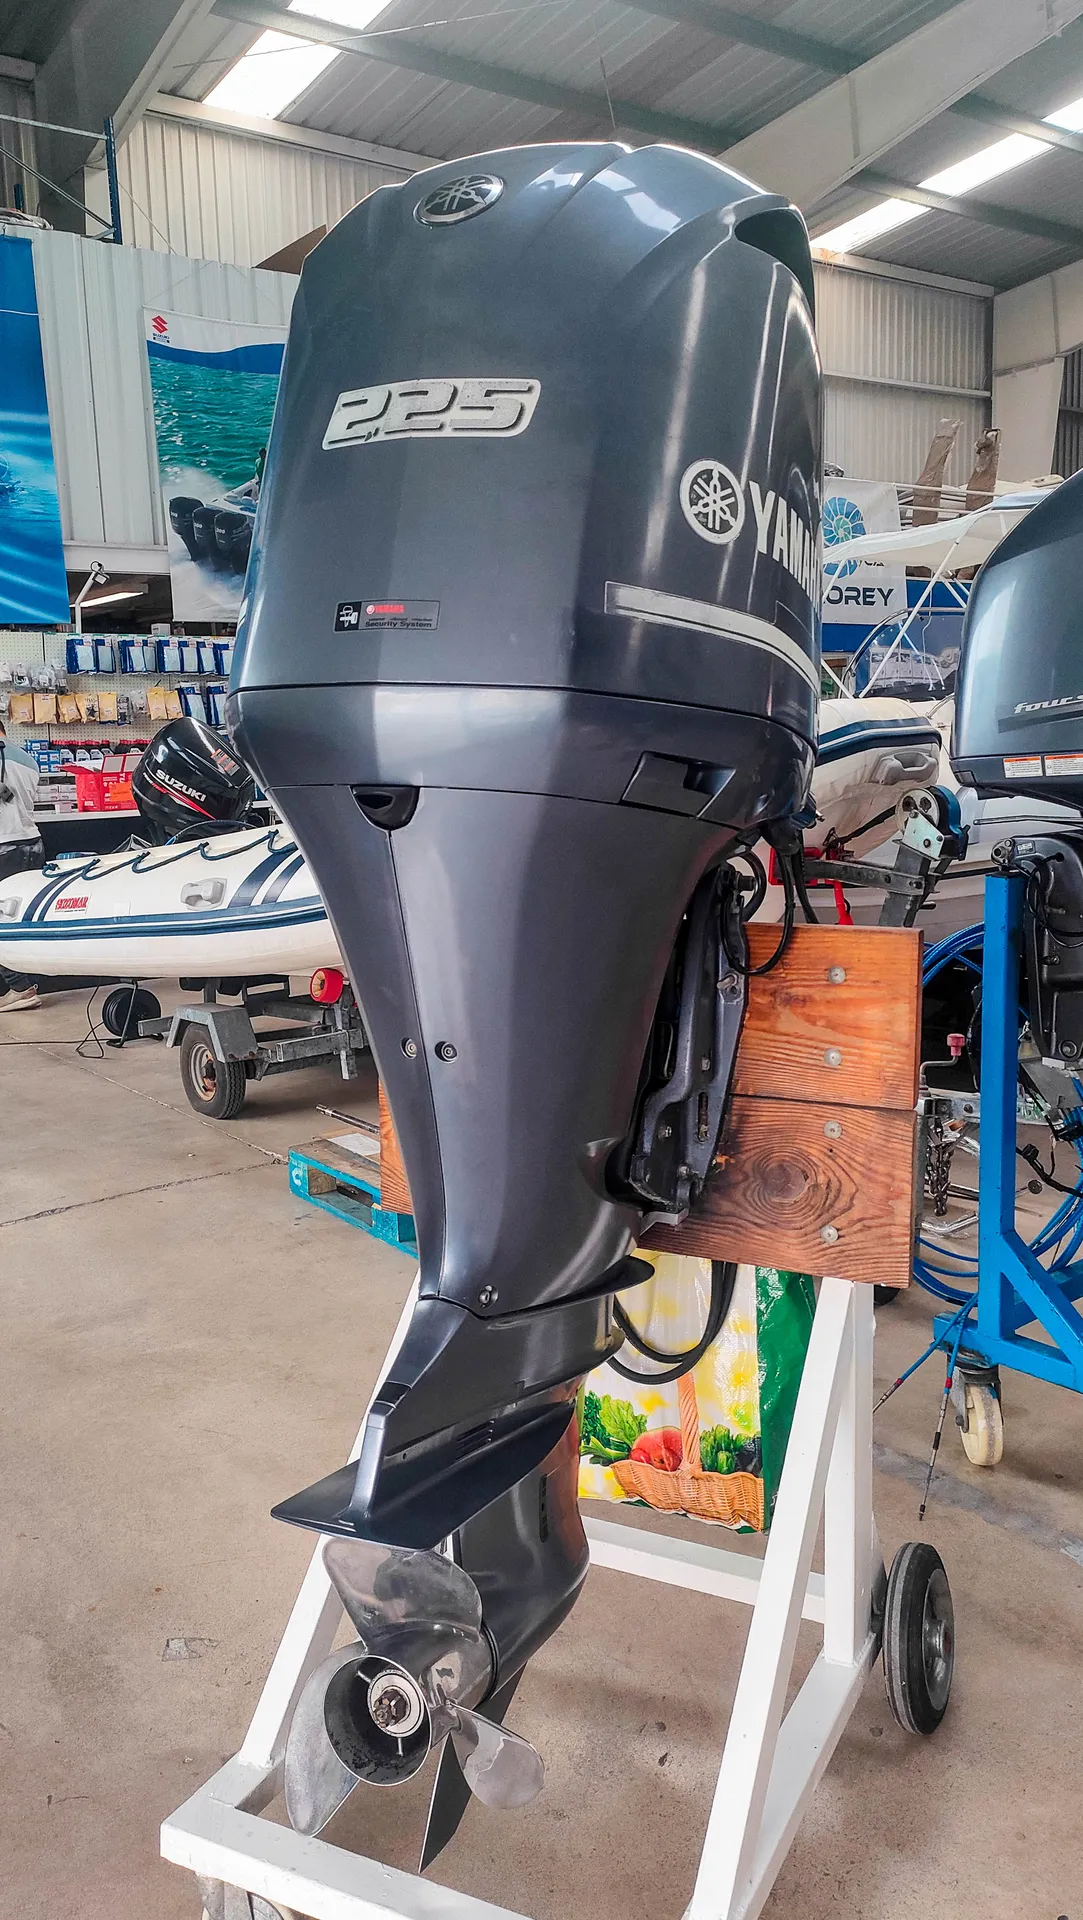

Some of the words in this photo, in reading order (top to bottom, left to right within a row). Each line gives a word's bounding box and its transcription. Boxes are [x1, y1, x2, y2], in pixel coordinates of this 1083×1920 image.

[324, 378, 538, 448] 225
[823, 585, 894, 606] OREY
[365, 620, 398, 628] Security
[400, 620, 432, 629] System
[155, 768, 207, 802] SUZUKI
